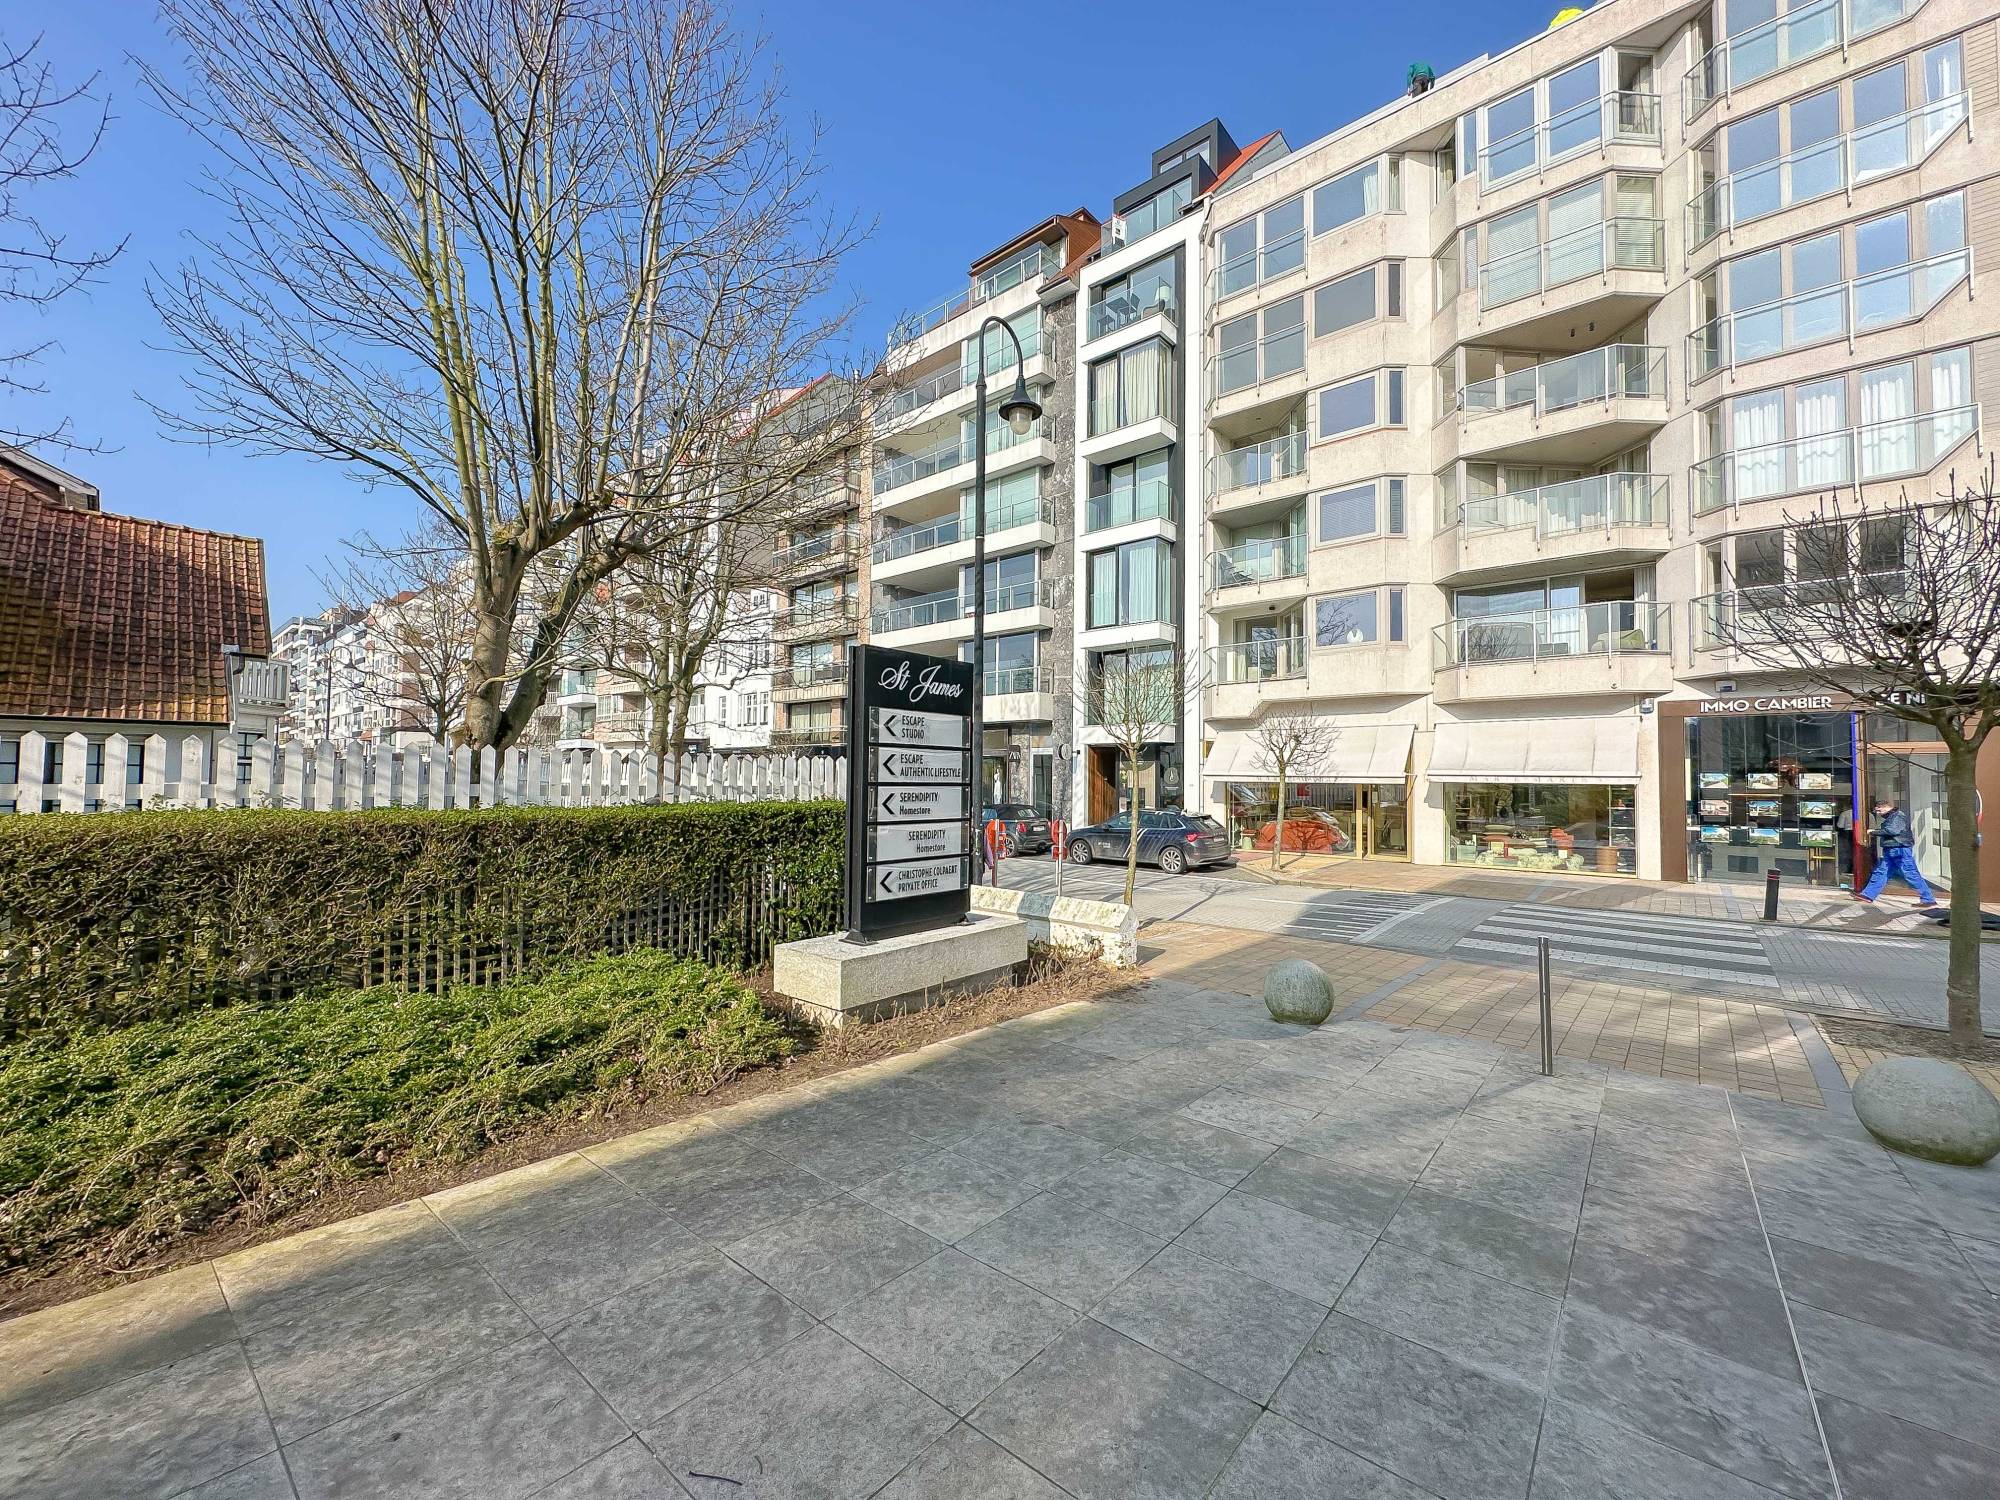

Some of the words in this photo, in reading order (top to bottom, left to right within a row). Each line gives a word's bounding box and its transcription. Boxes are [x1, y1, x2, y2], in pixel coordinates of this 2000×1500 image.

[878, 660, 911, 691] St
[908, 665, 964, 703] James
[1700, 700, 1750, 713] IMMO
[1754, 696, 1833, 711] CAMBIER
[901, 715, 925, 727] ESCAPE
[901, 728, 925, 739] STUDIO
[900, 753, 924, 764] ESCAPE
[899, 766, 934, 777] AUTHENTIC
[934, 767, 961, 778] LIFESTYLE
[899, 791, 939, 802] SERENDIPITY
[899, 805, 931, 815] Homestore
[908, 829, 946, 841] SERENDIPITY
[916, 843, 946, 853] Homestore
[898, 867, 933, 880] CHRISTOPHE
[933, 864, 958, 876] COLPAERT
[898, 880, 920, 893] PRIVATE
[921, 878, 938, 890] OFFICE
